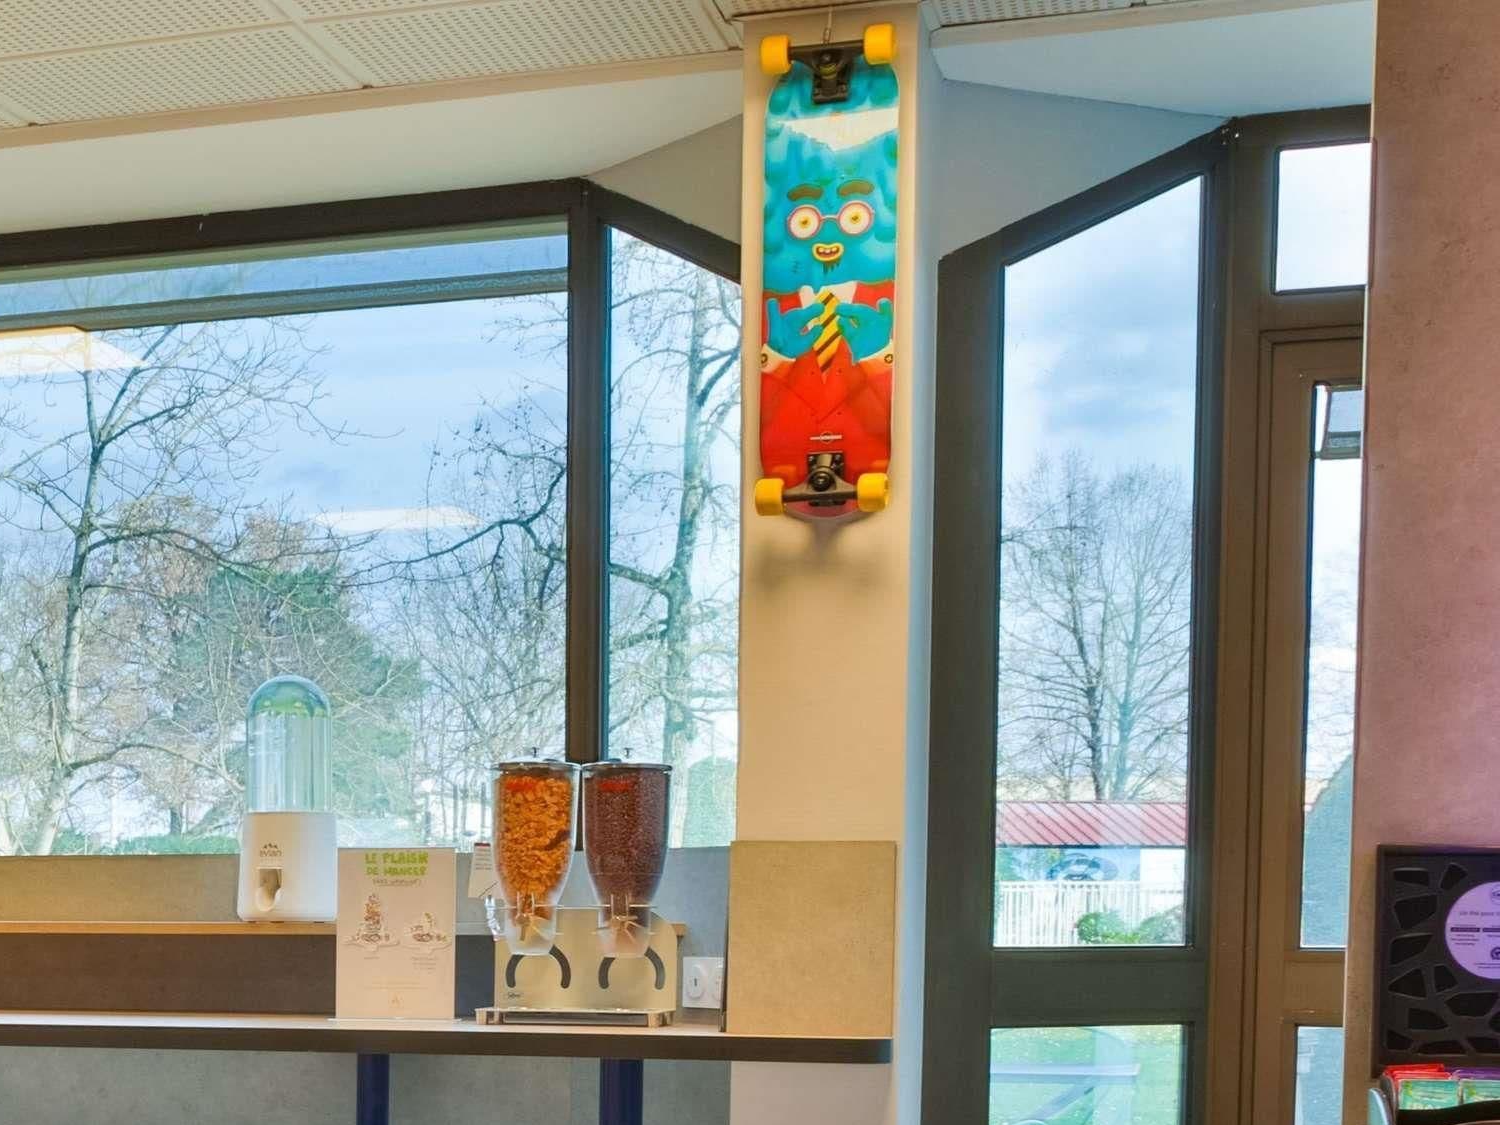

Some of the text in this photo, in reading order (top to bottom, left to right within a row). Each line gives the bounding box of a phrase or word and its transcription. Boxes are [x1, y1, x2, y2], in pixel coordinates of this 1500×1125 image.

[364, 851, 428, 864] LE PLAISIR
[366, 866, 379, 876] DE
